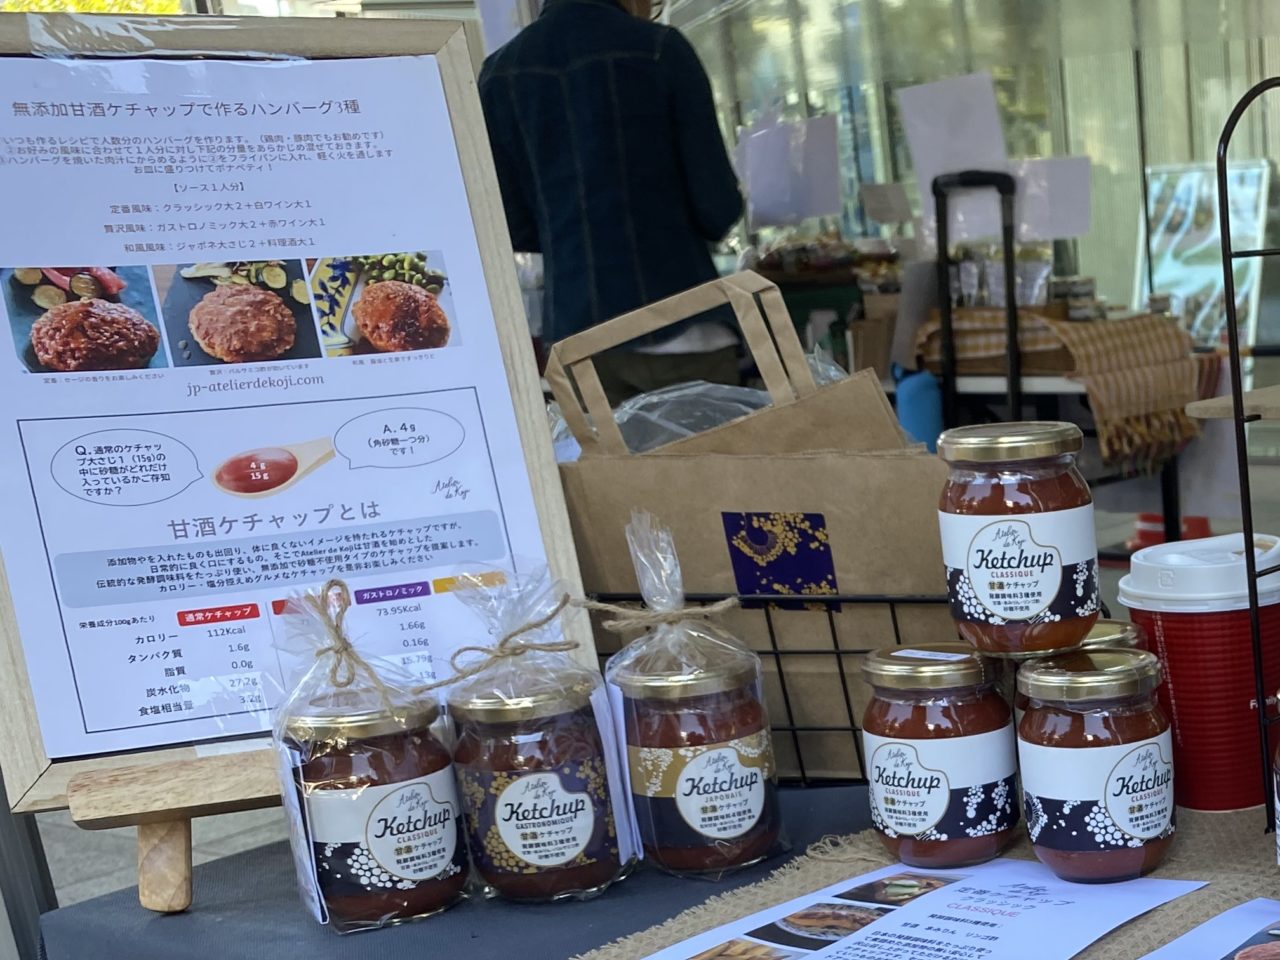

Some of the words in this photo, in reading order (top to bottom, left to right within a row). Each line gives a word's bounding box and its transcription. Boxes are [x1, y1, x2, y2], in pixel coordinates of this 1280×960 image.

[12, 99, 361, 117] 無添加甘酒ケチャップで作るハンバーグ3種
[186, 375, 325, 397] jp-atelierdekoji.com
[79, 464, 167, 476] 中に砂糖がどれだけ
[82, 473, 170, 487] 入っているかご存知
[84, 486, 122, 496] ですか？
[167, 501, 381, 540] 甘酒ケチャップとは
[973, 549, 1053, 573] Ketchup
[991, 570, 1034, 578] CLASSIQUE
[362, 586, 424, 599] ガストロノミック
[185, 606, 252, 622] 通常ケチャップ
[135, 633, 179, 645] カロリー
[207, 626, 246, 638] 112Kcal
[377, 603, 421, 617] 73.95Kcal
[128, 649, 183, 663] タンパク質
[229, 643, 250, 653] 1.6g
[400, 621, 426, 631] 1.66g
[164, 667, 186, 677] 脂質
[232, 660, 253, 669] 0.0g
[403, 638, 429, 648] 0.16g
[146, 683, 191, 697] 炭水化物
[139, 700, 194, 716] 食塩相当量
[683, 772, 758, 796] Ketchup
[875, 766, 940, 794] Ketchup
[705, 792, 742, 803] JAPONAIS
[885, 788, 920, 796] CLASSIQUE
[1131, 789, 1163, 802] CLASSIQUE
[503, 799, 586, 822] Ketchup
[375, 808, 450, 838] Ketchup
[516, 816, 574, 829] GASTRONOMIQUE
[397, 828, 438, 843] CLASSIQUE
[946, 903, 1021, 917] CLASSIQUE
